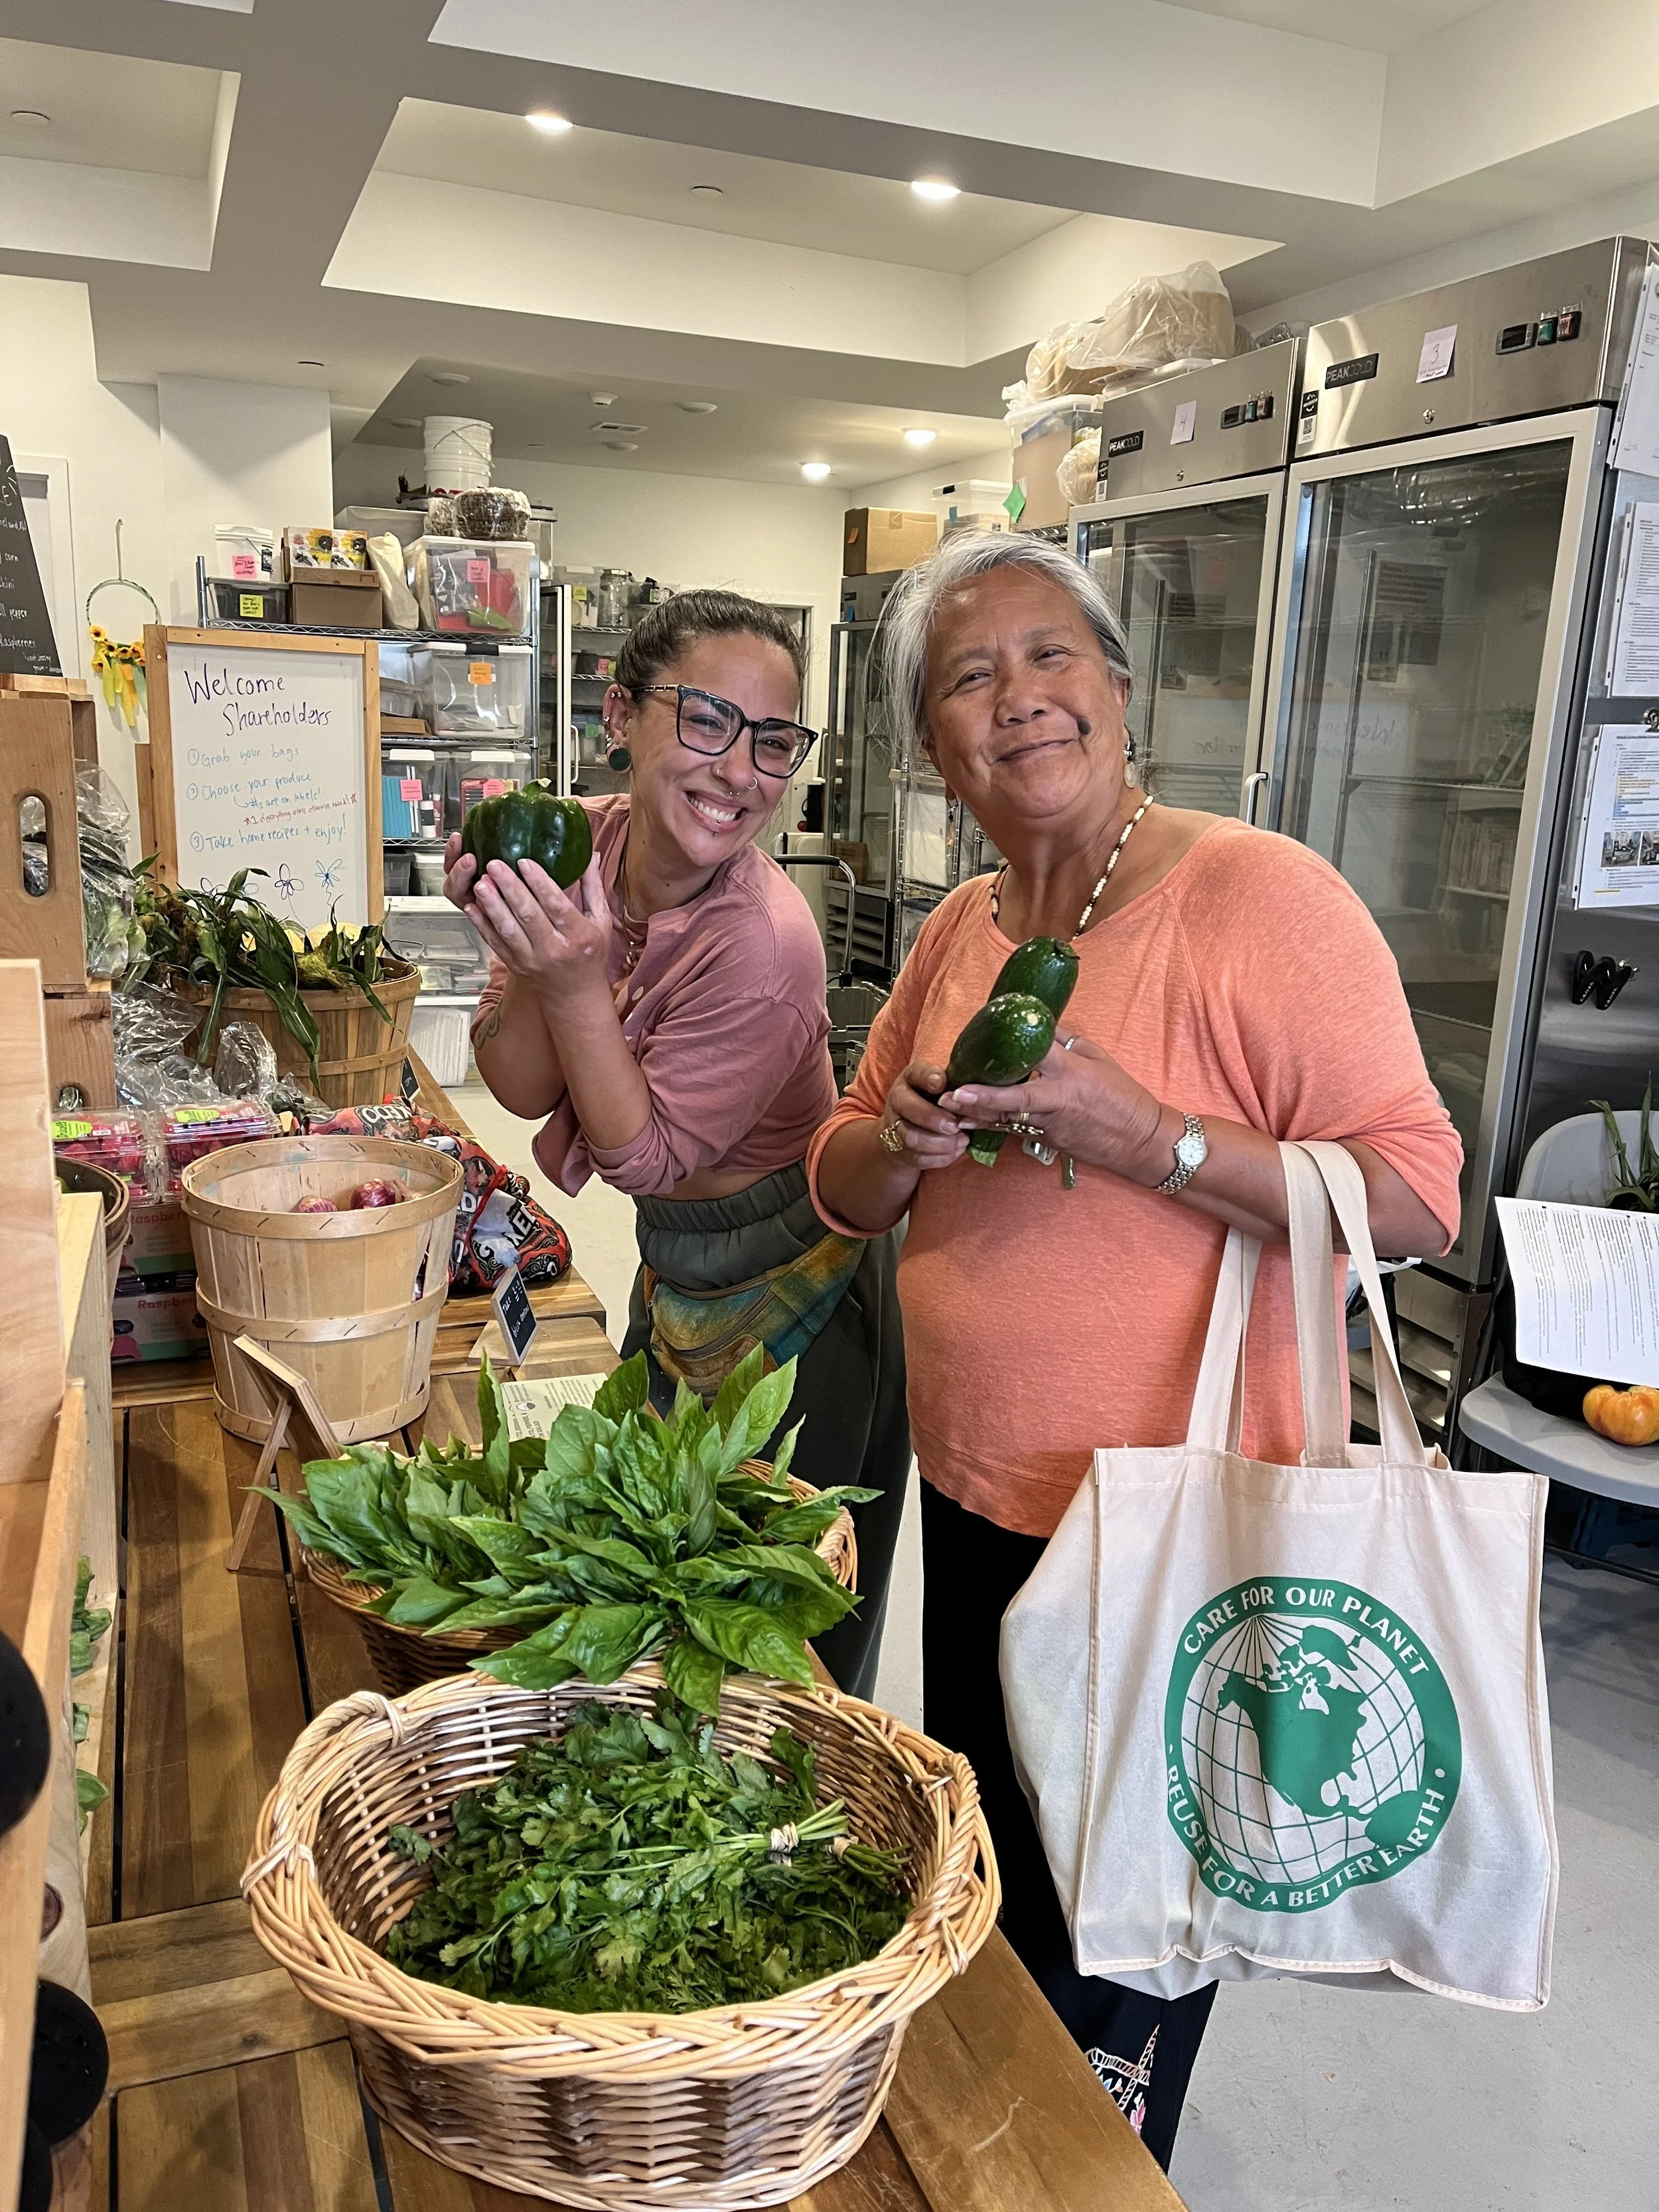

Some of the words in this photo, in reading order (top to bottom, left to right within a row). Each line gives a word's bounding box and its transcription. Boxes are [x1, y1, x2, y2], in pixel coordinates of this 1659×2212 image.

[1431, 343, 1440, 364] 3
[1326, 360, 1374, 382] PEAKCOLD
[1181, 412, 1188, 432] 4
[1109, 435, 1141, 453] PEAKCOLD
[5, 553, 19, 562] corn
[184, 662, 285, 704] Welcome
[222, 701, 332, 737] Shareholders
[201, 747, 230, 768] Grab
[240, 749, 261, 765] your
[271, 743, 300, 762] bags
[202, 782, 242, 800] Choose
[248, 778, 268, 794] your
[275, 771, 313, 790] produce
[265, 798, 279, 807] are
[294, 786, 321, 802] labels!
[206, 835, 234, 849] Take
[238, 829, 265, 844] home
[267, 826, 299, 840] recipes
[315, 812, 346, 846] enjoy!
[1183, 1599, 1238, 1655] CARE
[1241, 1585, 1275, 1610] FOR
[1285, 1586, 1336, 1607] OUR
[1342, 1595, 1430, 1676] PLANET
[1166, 1763, 1206, 1852] REUSE
[1202, 1859, 1256, 1902] FOR
[1260, 1889, 1279, 1906] A
[1287, 1854, 1381, 1907] BETTER
[1381, 1788, 1447, 1867] EARTH
